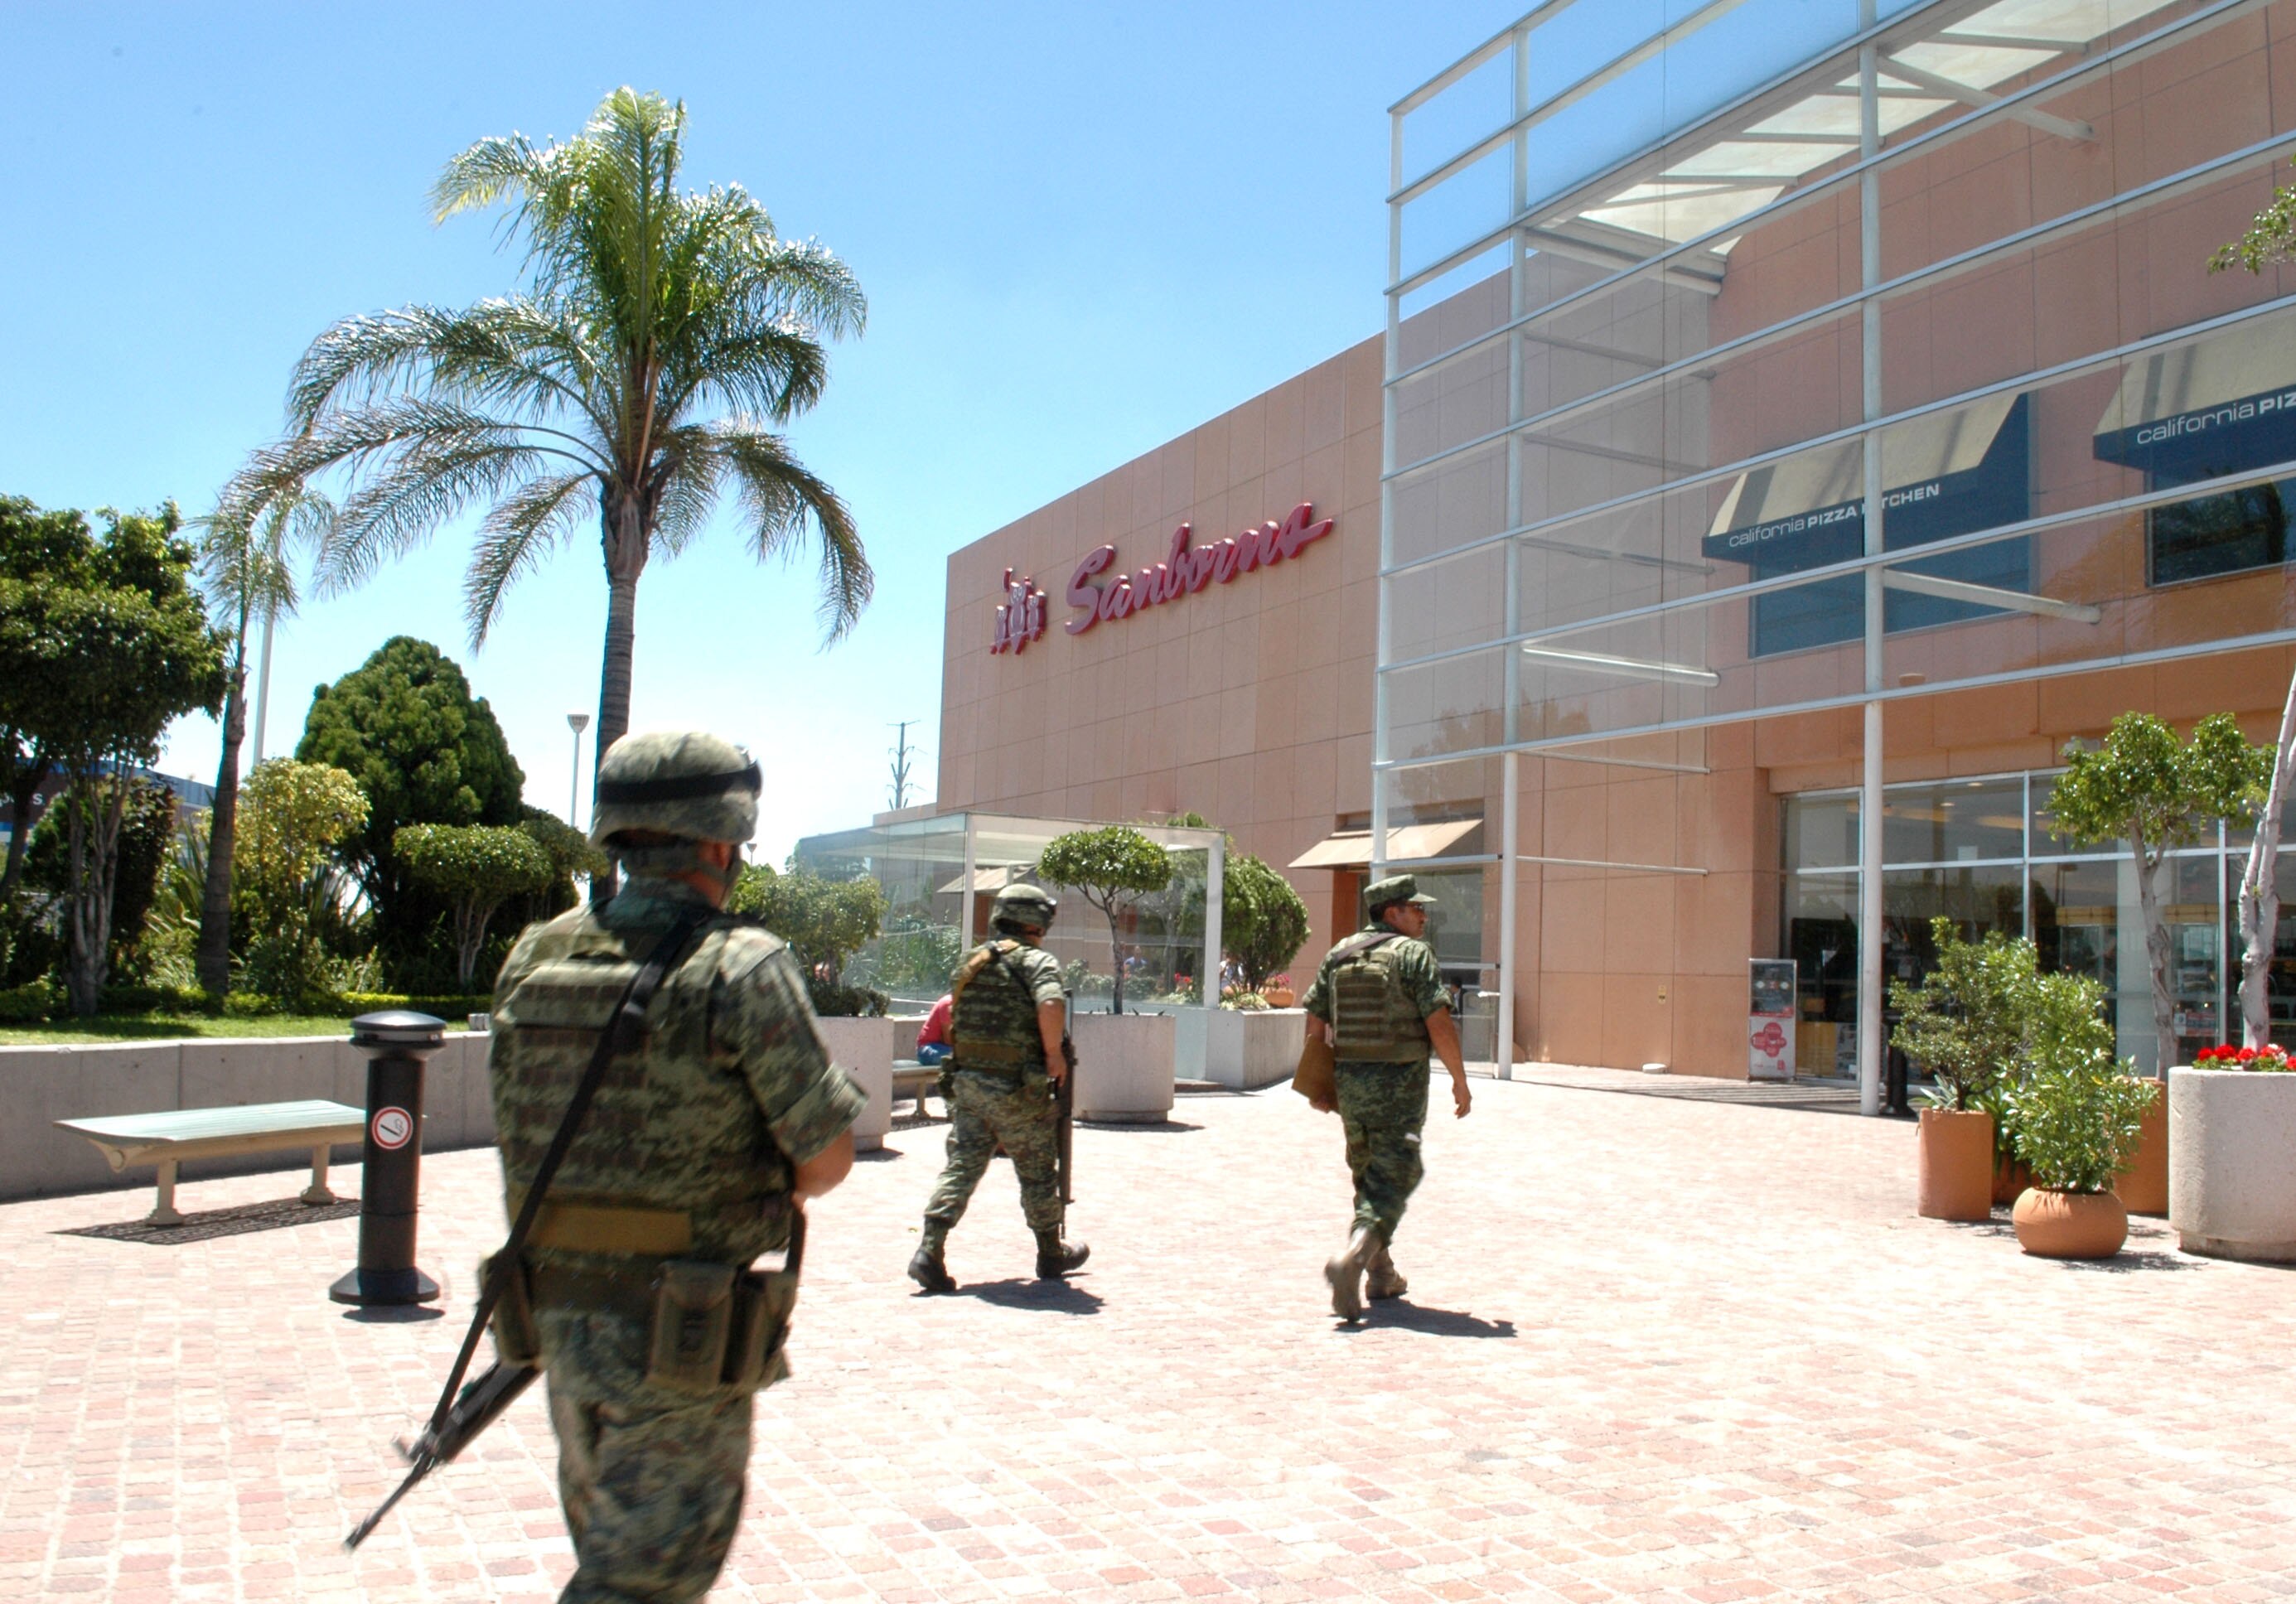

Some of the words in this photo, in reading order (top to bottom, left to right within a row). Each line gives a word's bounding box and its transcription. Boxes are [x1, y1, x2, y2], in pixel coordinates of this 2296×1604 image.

[2136, 403, 2255, 445] california
[1728, 517, 1805, 548] california
[1807, 505, 1857, 528] PIZZA
[1065, 501, 1334, 635] Sanborns
